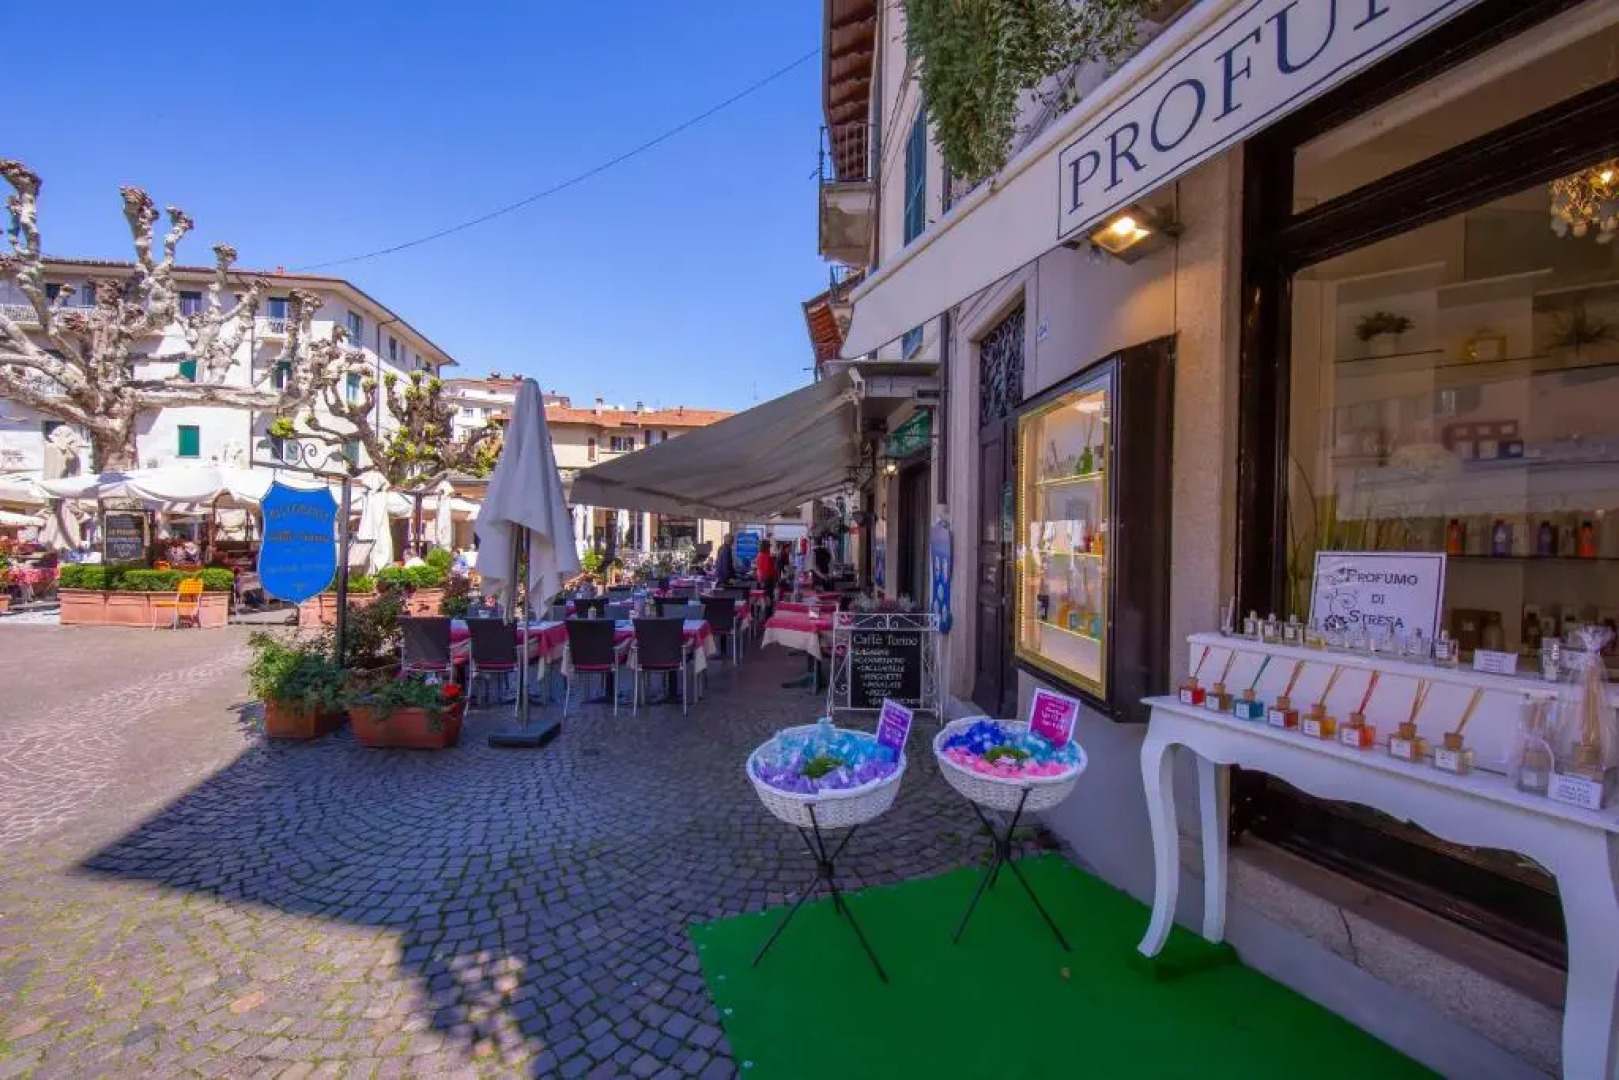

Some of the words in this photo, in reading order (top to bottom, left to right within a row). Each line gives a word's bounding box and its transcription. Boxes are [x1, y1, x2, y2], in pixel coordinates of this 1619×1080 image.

[1345, 568, 1419, 586] PROFUMO
[1371, 594, 1386, 605] DI
[1348, 609, 1405, 629] STRESA
[888, 634, 918, 646] Torino
